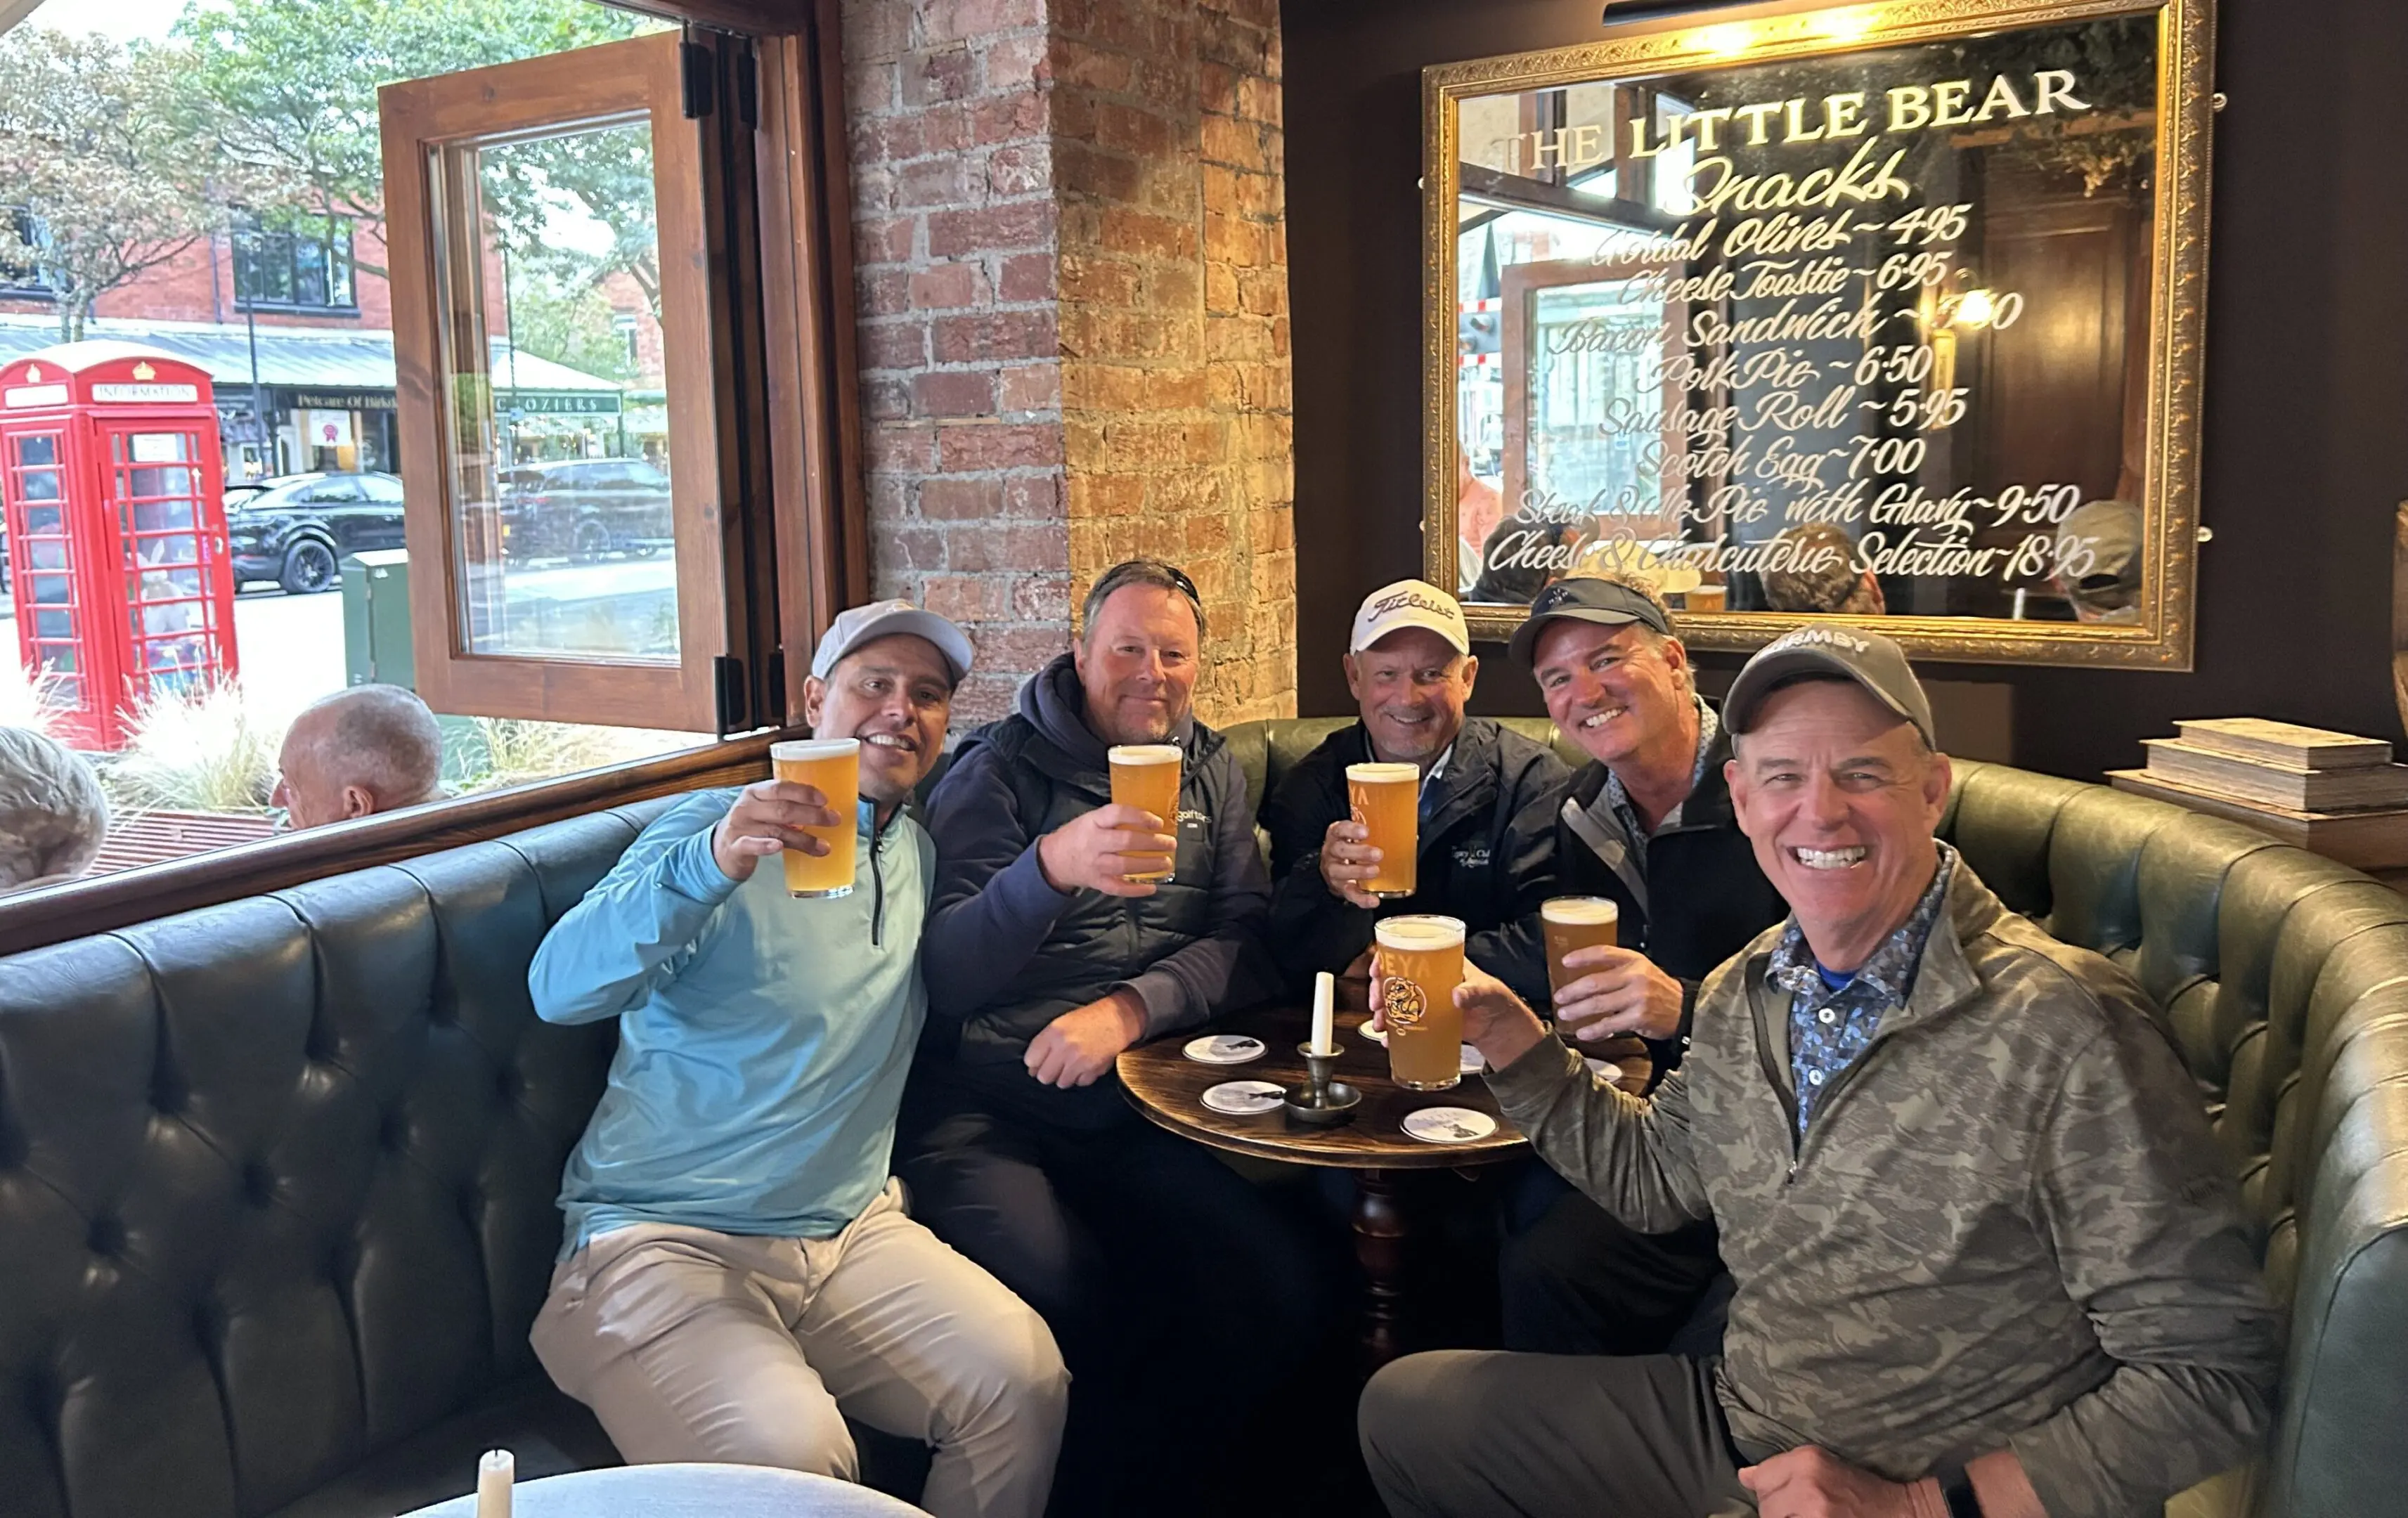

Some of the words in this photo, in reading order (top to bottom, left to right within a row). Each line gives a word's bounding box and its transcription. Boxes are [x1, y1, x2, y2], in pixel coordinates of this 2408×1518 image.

[1488, 124, 1603, 173] THE
[1628, 91, 1869, 159] LITTLE
[1886, 69, 2092, 132] BEAR
[1661, 136, 1911, 216] Snacks
[1722, 208, 1854, 258] Olives
[1617, 265, 1735, 304] Cheese
[1729, 256, 1851, 301] Toastie
[1546, 316, 1675, 355] Bacon
[1682, 292, 1888, 347] Sandwich
[1636, 350, 1738, 394] Pork
[1730, 346, 1821, 389] Pie
[496, 397, 597, 412] COZIERS
[1598, 397, 1740, 446] Sausage
[1738, 384, 1856, 432] Roll
[1636, 434, 1754, 478] Scotch
[1755, 434, 1829, 490] Egg
[1514, 488, 1606, 526] Steak
[1607, 484, 1640, 526] &
[1692, 483, 1771, 524] Pie
[1785, 479, 1866, 523] with
[1870, 483, 1974, 536] Gravy
[1489, 528, 1591, 571] Cheese
[1597, 527, 1637, 571] &
[1638, 528, 1843, 573] Charcuterie
[1849, 528, 1994, 577] Selection
[1368, 590, 1455, 622] Titleist
